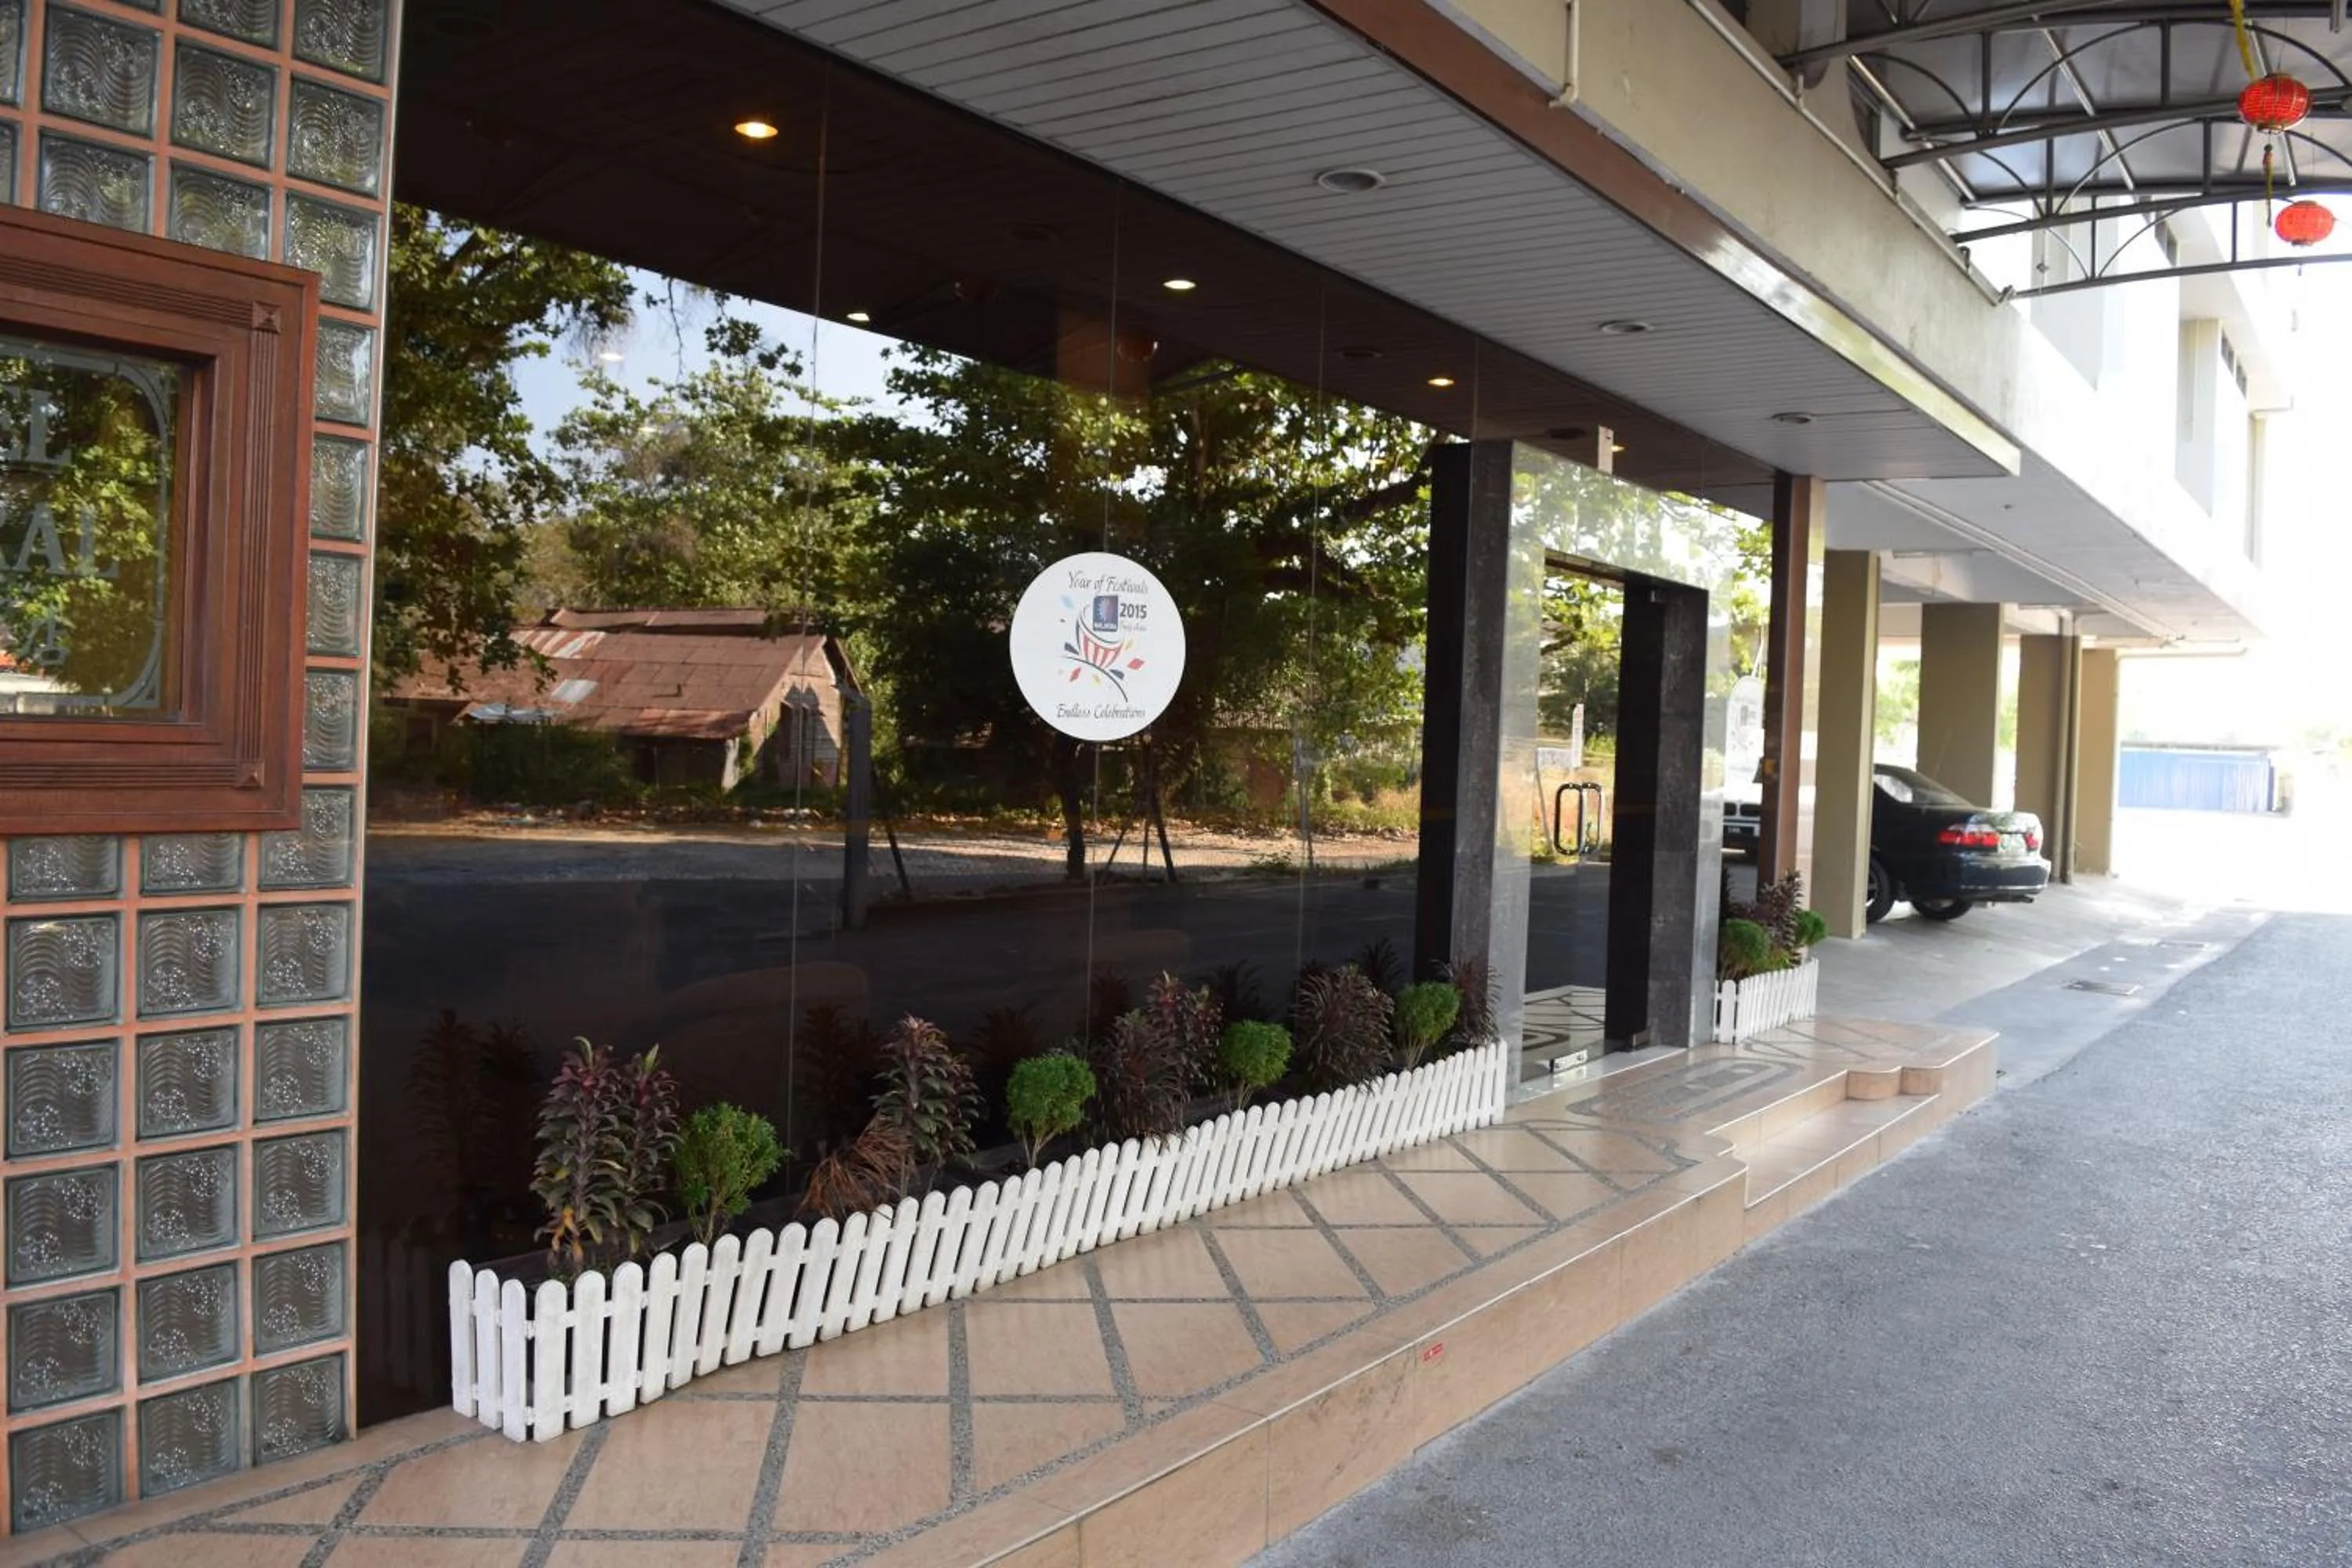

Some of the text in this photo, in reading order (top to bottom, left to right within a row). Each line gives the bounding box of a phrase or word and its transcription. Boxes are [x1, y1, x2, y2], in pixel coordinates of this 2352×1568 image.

[0, 501, 120, 579] AL
[1069, 571, 1091, 588] Year
[1094, 574, 1105, 593] of
[1120, 603, 1147, 619] 2015
